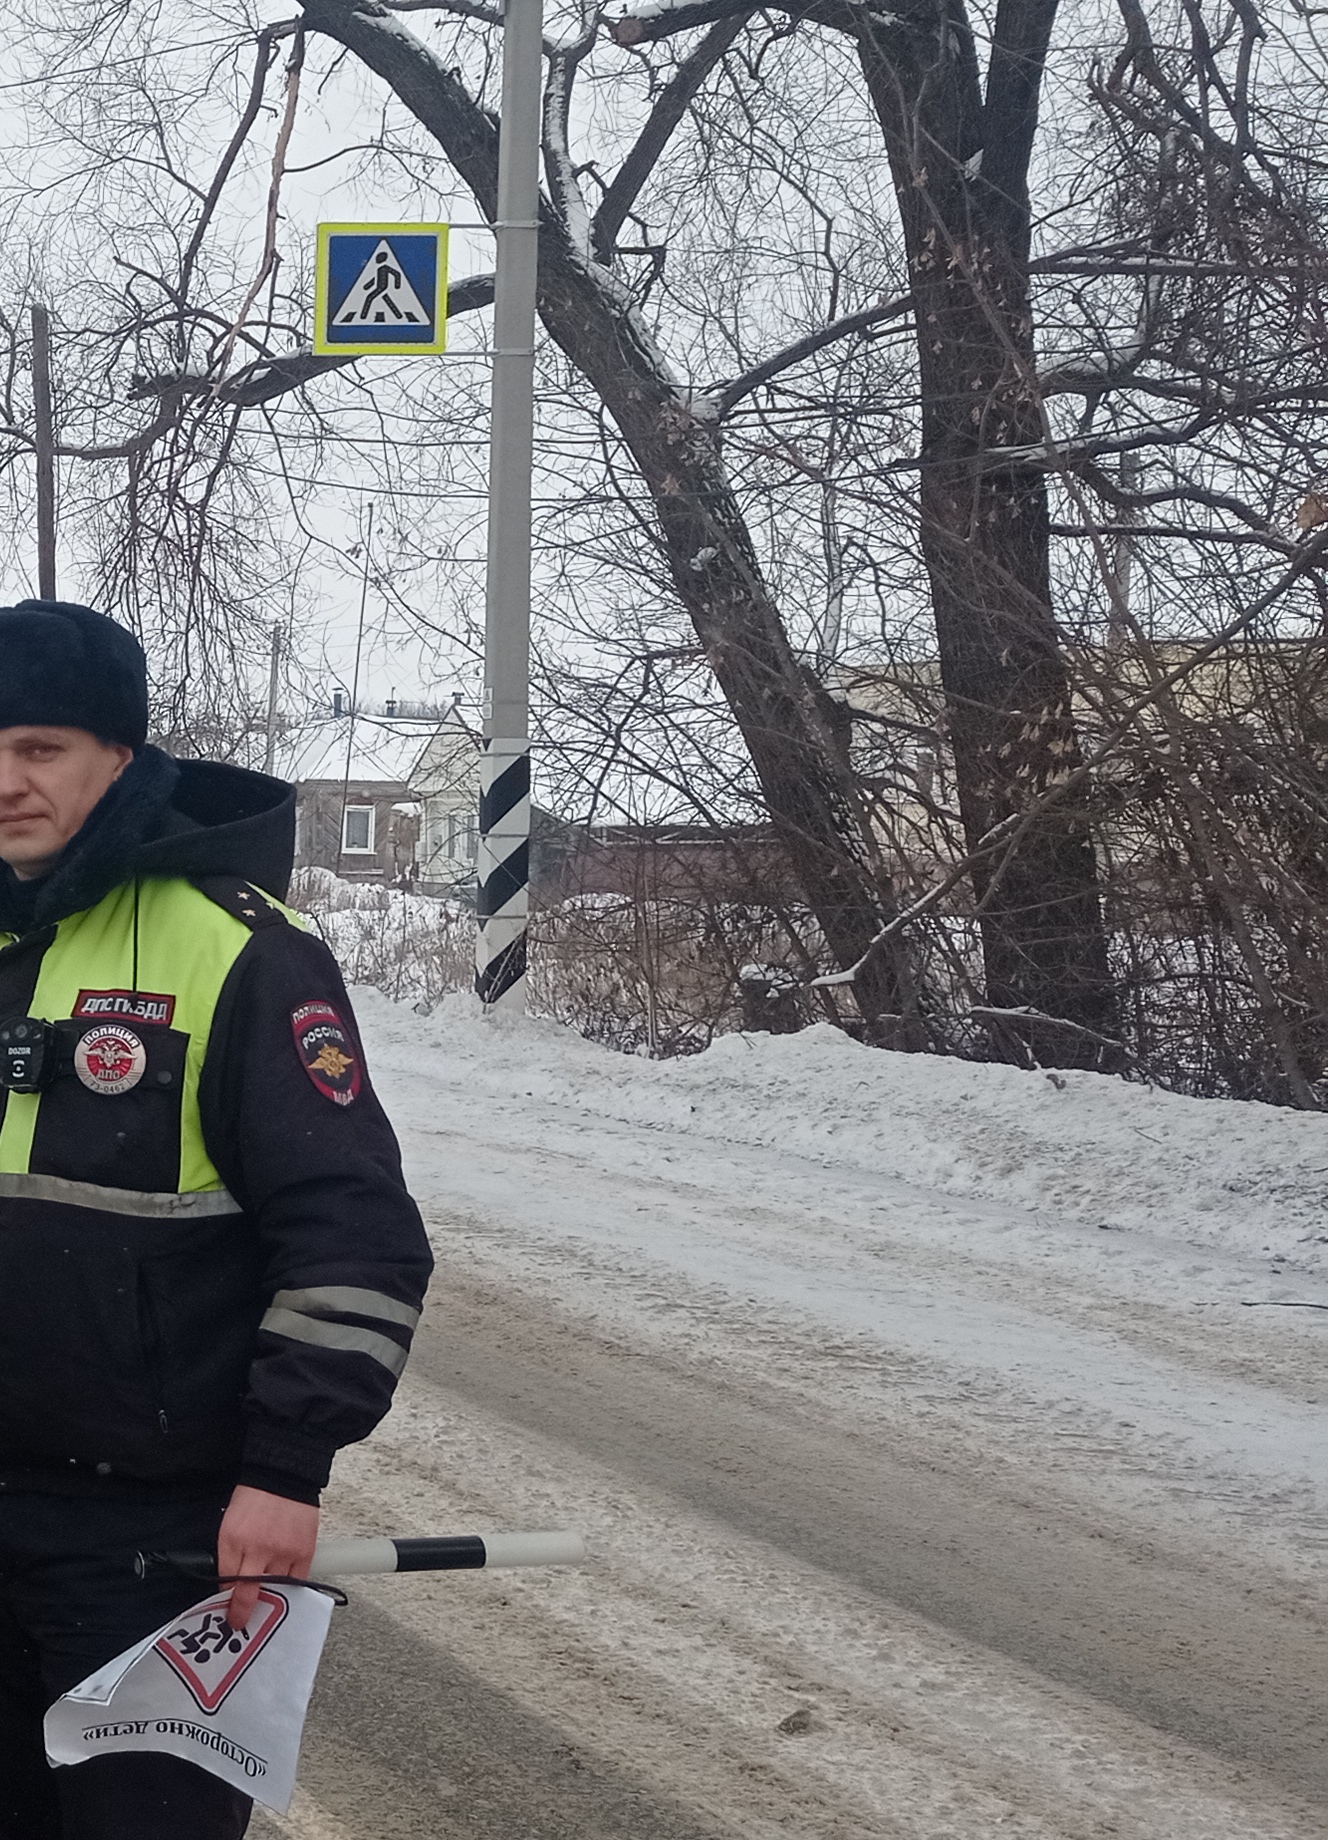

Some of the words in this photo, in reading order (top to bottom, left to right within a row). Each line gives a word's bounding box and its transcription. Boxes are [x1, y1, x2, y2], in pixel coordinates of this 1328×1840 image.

[292, 1004, 334, 1024] ПОЛИЦИЯ
[84, 1027, 140, 1049] ПОЛИЦИЯ
[302, 1026, 344, 1049] РОССИЯ
